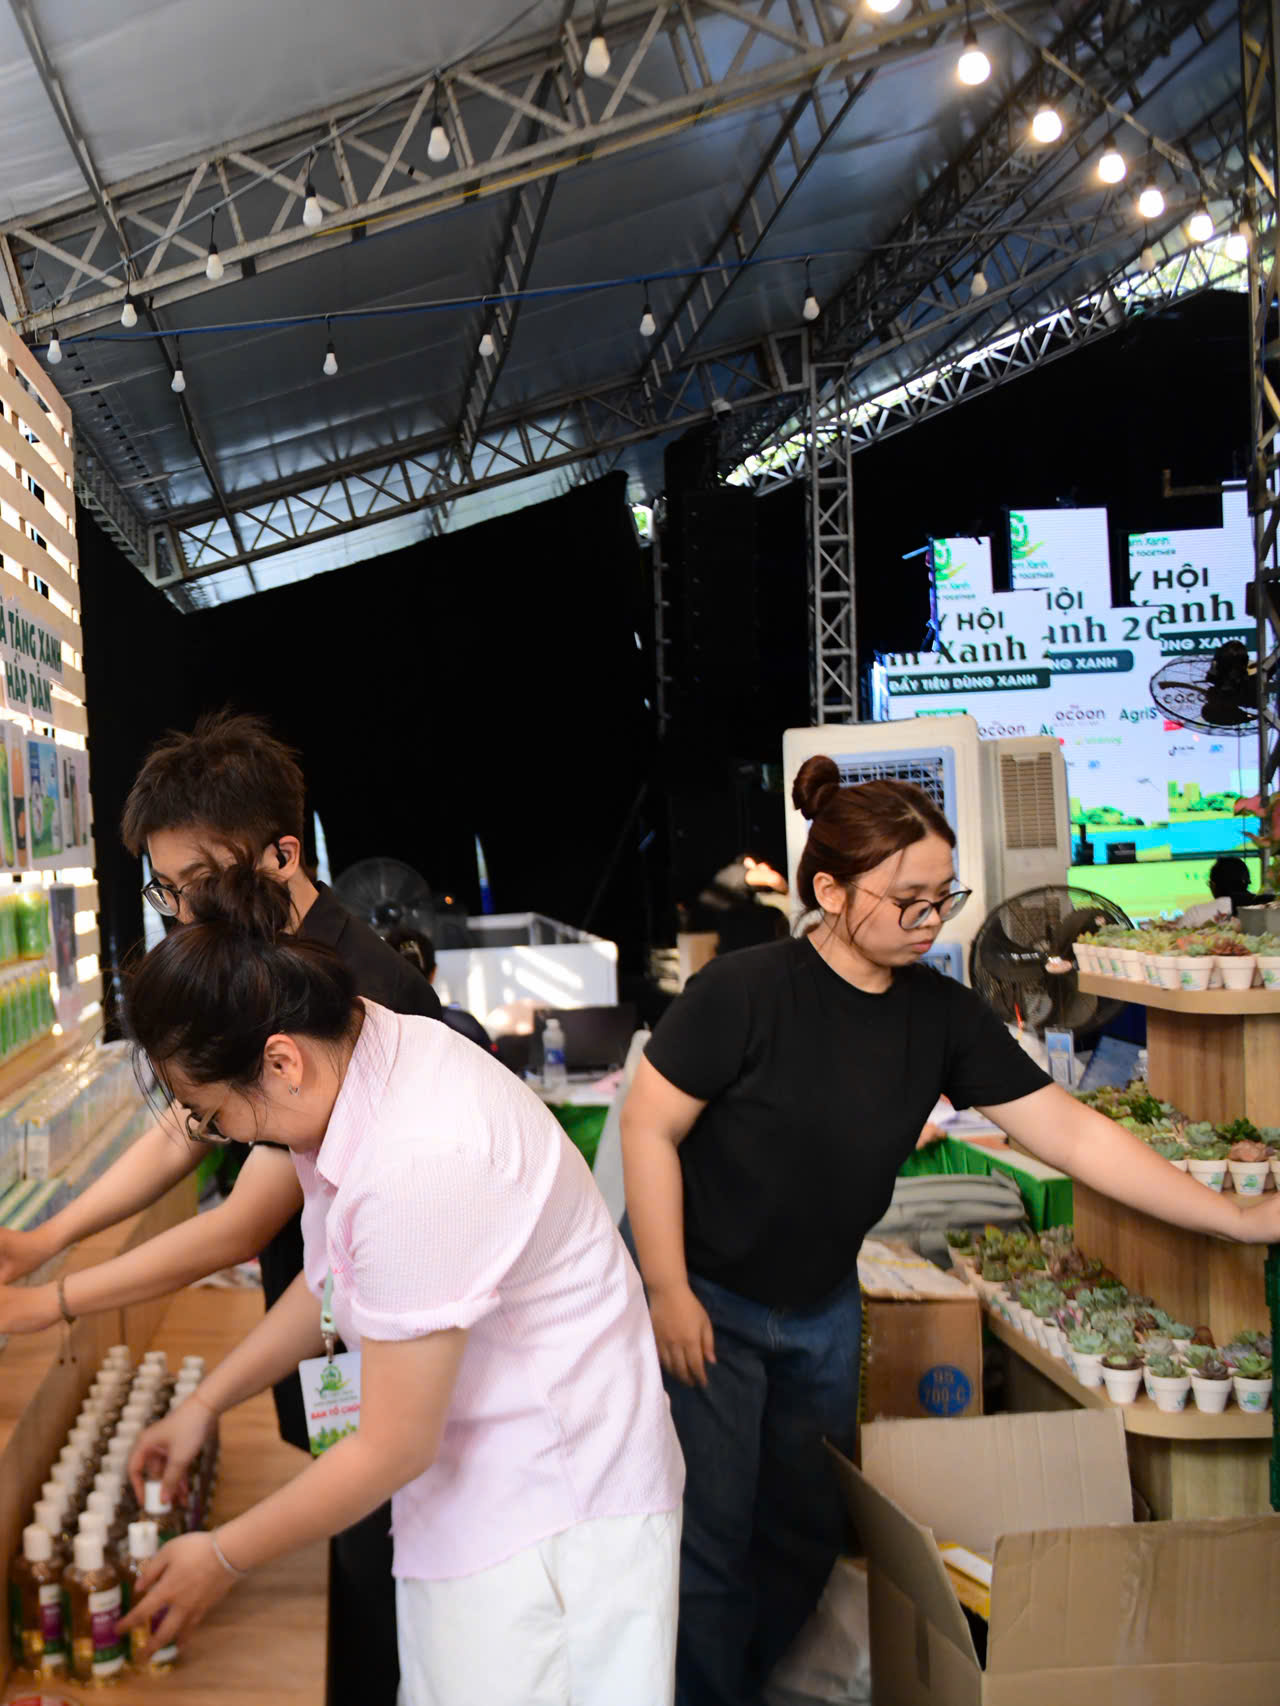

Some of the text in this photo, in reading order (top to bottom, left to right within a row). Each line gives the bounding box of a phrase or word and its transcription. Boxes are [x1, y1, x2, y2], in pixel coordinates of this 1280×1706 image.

[1153, 562, 1209, 594] HỘI
[956, 606, 1004, 635] HỘI
[997, 674, 1039, 687] XANH
